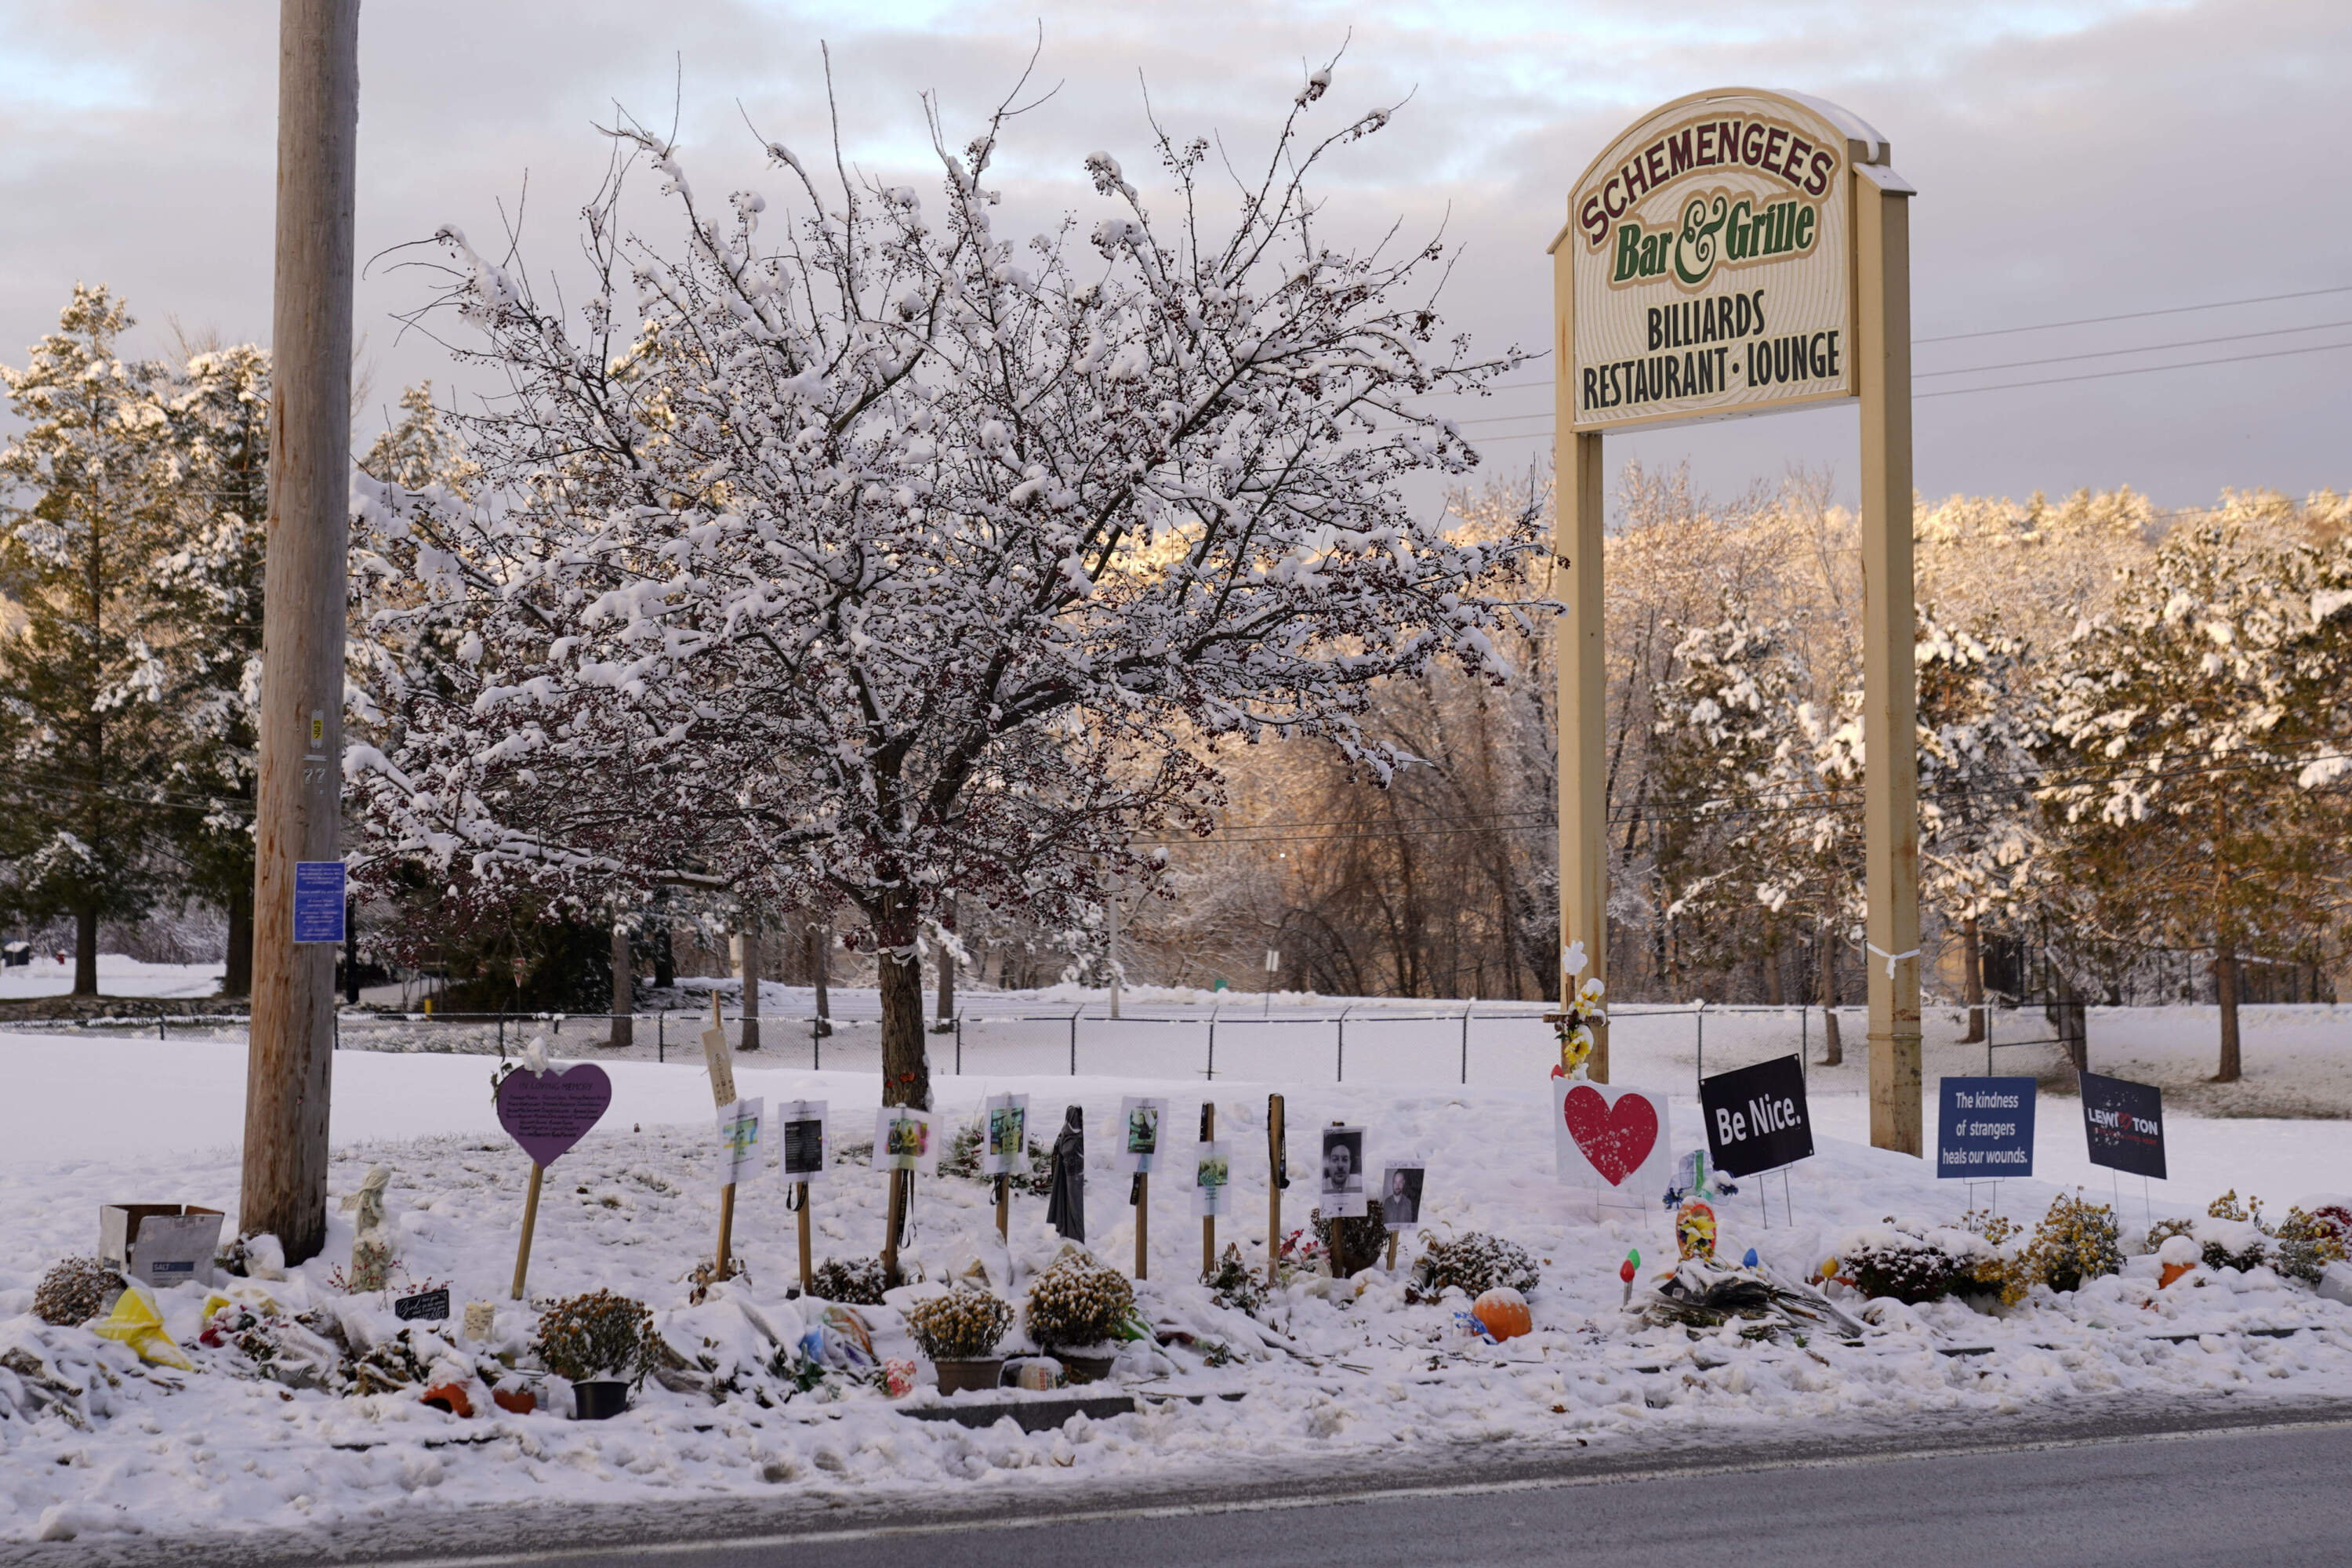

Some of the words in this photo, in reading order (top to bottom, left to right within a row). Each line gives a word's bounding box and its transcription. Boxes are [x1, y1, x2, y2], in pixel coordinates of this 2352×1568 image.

[1581, 121, 1834, 245] SCHEMENGEES
[1614, 224, 1673, 282] Bar
[1675, 196, 1726, 284] &
[1726, 201, 1816, 261] Grille
[1648, 289, 1766, 352] BILLIARDS
[1583, 347, 1729, 411] RESTAURANT
[1748, 330, 1839, 388] LOUNGE
[1716, 1108, 1747, 1146] Be
[1748, 1093, 1802, 1137] Nice.
[1956, 1091, 1973, 1109] The
[1976, 1091, 2019, 1109] kindness
[1943, 1147, 1967, 1164] heals
[1969, 1150, 1985, 1163] our
[1986, 1146, 2028, 1164] wounds.
[1956, 1119, 1967, 1136] of
[1969, 1121, 2016, 1140] strangers
